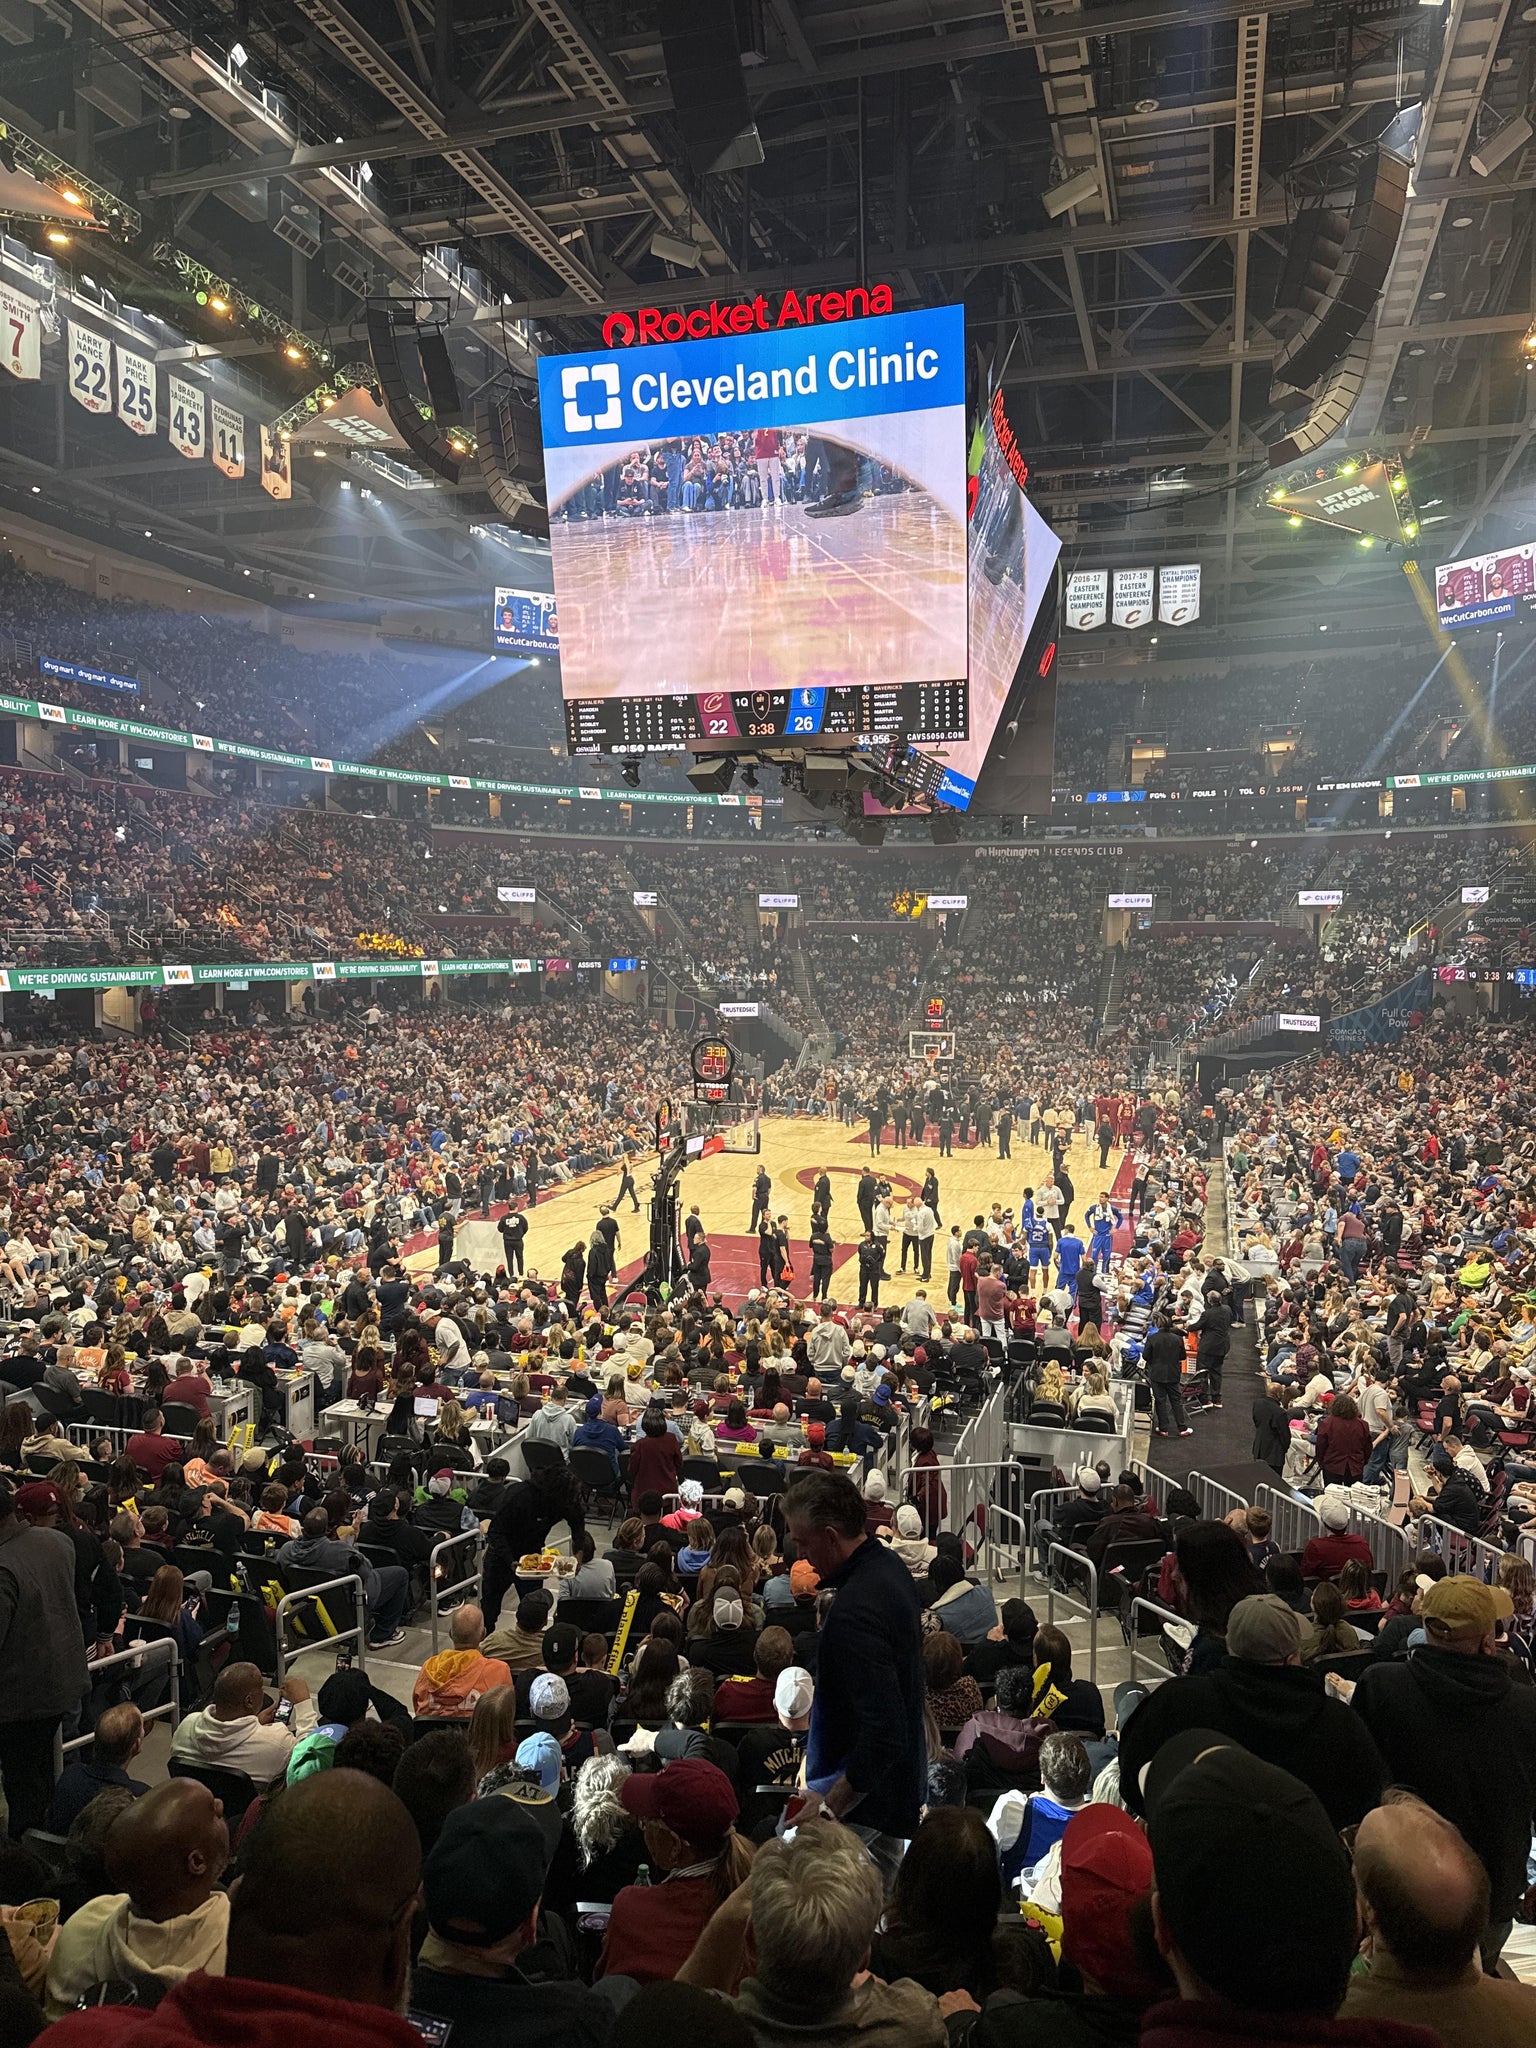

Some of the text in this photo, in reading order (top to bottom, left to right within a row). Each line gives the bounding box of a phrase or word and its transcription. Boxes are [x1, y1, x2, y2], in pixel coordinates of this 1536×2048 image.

[3, 300, 30, 322] SMITH
[638, 284, 893, 343] Rocket Arena
[9, 318, 24, 358] 7
[77, 329, 102, 348] LARRY
[76, 340, 103, 361] NANCE
[125, 356, 147, 373] MARK
[74, 353, 107, 400] 22
[125, 366, 148, 383] PRICE
[631, 341, 939, 412] Cleveland Clinic
[177, 384, 195, 399] BRAD
[122, 378, 152, 422] 25
[213, 404, 242, 425] ZYDRUNAS
[173, 405, 200, 446] 43
[219, 428, 239, 465] 11
[1316, 484, 1370, 507] LET EM
[1073, 574, 1101, 583] 2016-17
[1119, 572, 1148, 580] 2017-18
[1162, 575, 1198, 583] CHAMPIONS
[1074, 585, 1099, 593] EASTERN
[1120, 582, 1146, 590] EASTERN
[1069, 592, 1104, 601] CONFERENCE
[1115, 590, 1151, 599] CONFERENCE
[1070, 601, 1102, 609] CHAMPIONS
[1116, 599, 1150, 607] CHAMPIONS
[1441, 604, 1512, 625] WeCutCarbon.com
[44, 661, 137, 689] drug mart drug mart drug mart
[735, 698, 749, 707] 1Q
[773, 696, 785, 705] 24
[709, 719, 728, 734] 22
[748, 723, 775, 735] 3:38
[794, 716, 813, 731] 26
[858, 734, 890, 745] $6,956
[907, 731, 965, 741] CAVS5050.COM
[576, 744, 601, 753] oswald
[647, 743, 686, 751] RAFFLE
[42, 708, 63, 719] WM
[72, 713, 97, 726] LEARN
[98, 718, 119, 731] MORE
[119, 722, 129, 732] AT
[129, 724, 188, 744] WM.COM/STORIES
[195, 737, 211, 748] WM
[237, 746, 260, 759] DRIVING
[314, 760, 330, 770] WM
[338, 764, 359, 773] LEARN
[359, 766, 378, 776] MORE
[378, 768, 386, 777] AT
[386, 769, 440, 784] WM.COM/STORIES
[452, 778, 468, 786] WM
[476, 780, 496, 789] WE'RE
[497, 782, 521, 792] DRIVING
[582, 789, 599, 797] WM
[606, 791, 627, 799] LEARN
[656, 794, 712, 803] WM.COM/STORIES
[1427, 775, 1451, 783] WE'RE
[1453, 772, 1485, 782] DRIVING
[1259, 787, 1265, 795] 6
[1317, 783, 1334, 791] LET
[18, 974, 49, 985] WE'RE
[51, 973, 88, 983] DRIVING
[167, 970, 189, 980] WM
[199, 969, 223, 978] LEARN
[223, 968, 243, 978] MORE
[243, 968, 253, 977] AT
[253, 967, 309, 977] WM.COM/STORIES
[316, 966, 333, 975] WM
[357, 965, 379, 973] DRIVING
[423, 964, 436, 972] WM
[441, 963, 457, 971] LEARN
[1455, 970, 1525, 981] 22 3:38 24 26
[927, 1004, 942, 1016] 24
[1382, 1009, 1398, 1018] Full
[1283, 1018, 1317, 1027] TRUSTEDSEC
[706, 1046, 727, 1058] 3:38
[702, 1057, 725, 1075] 24
[614, 1611, 628, 1646] planet
